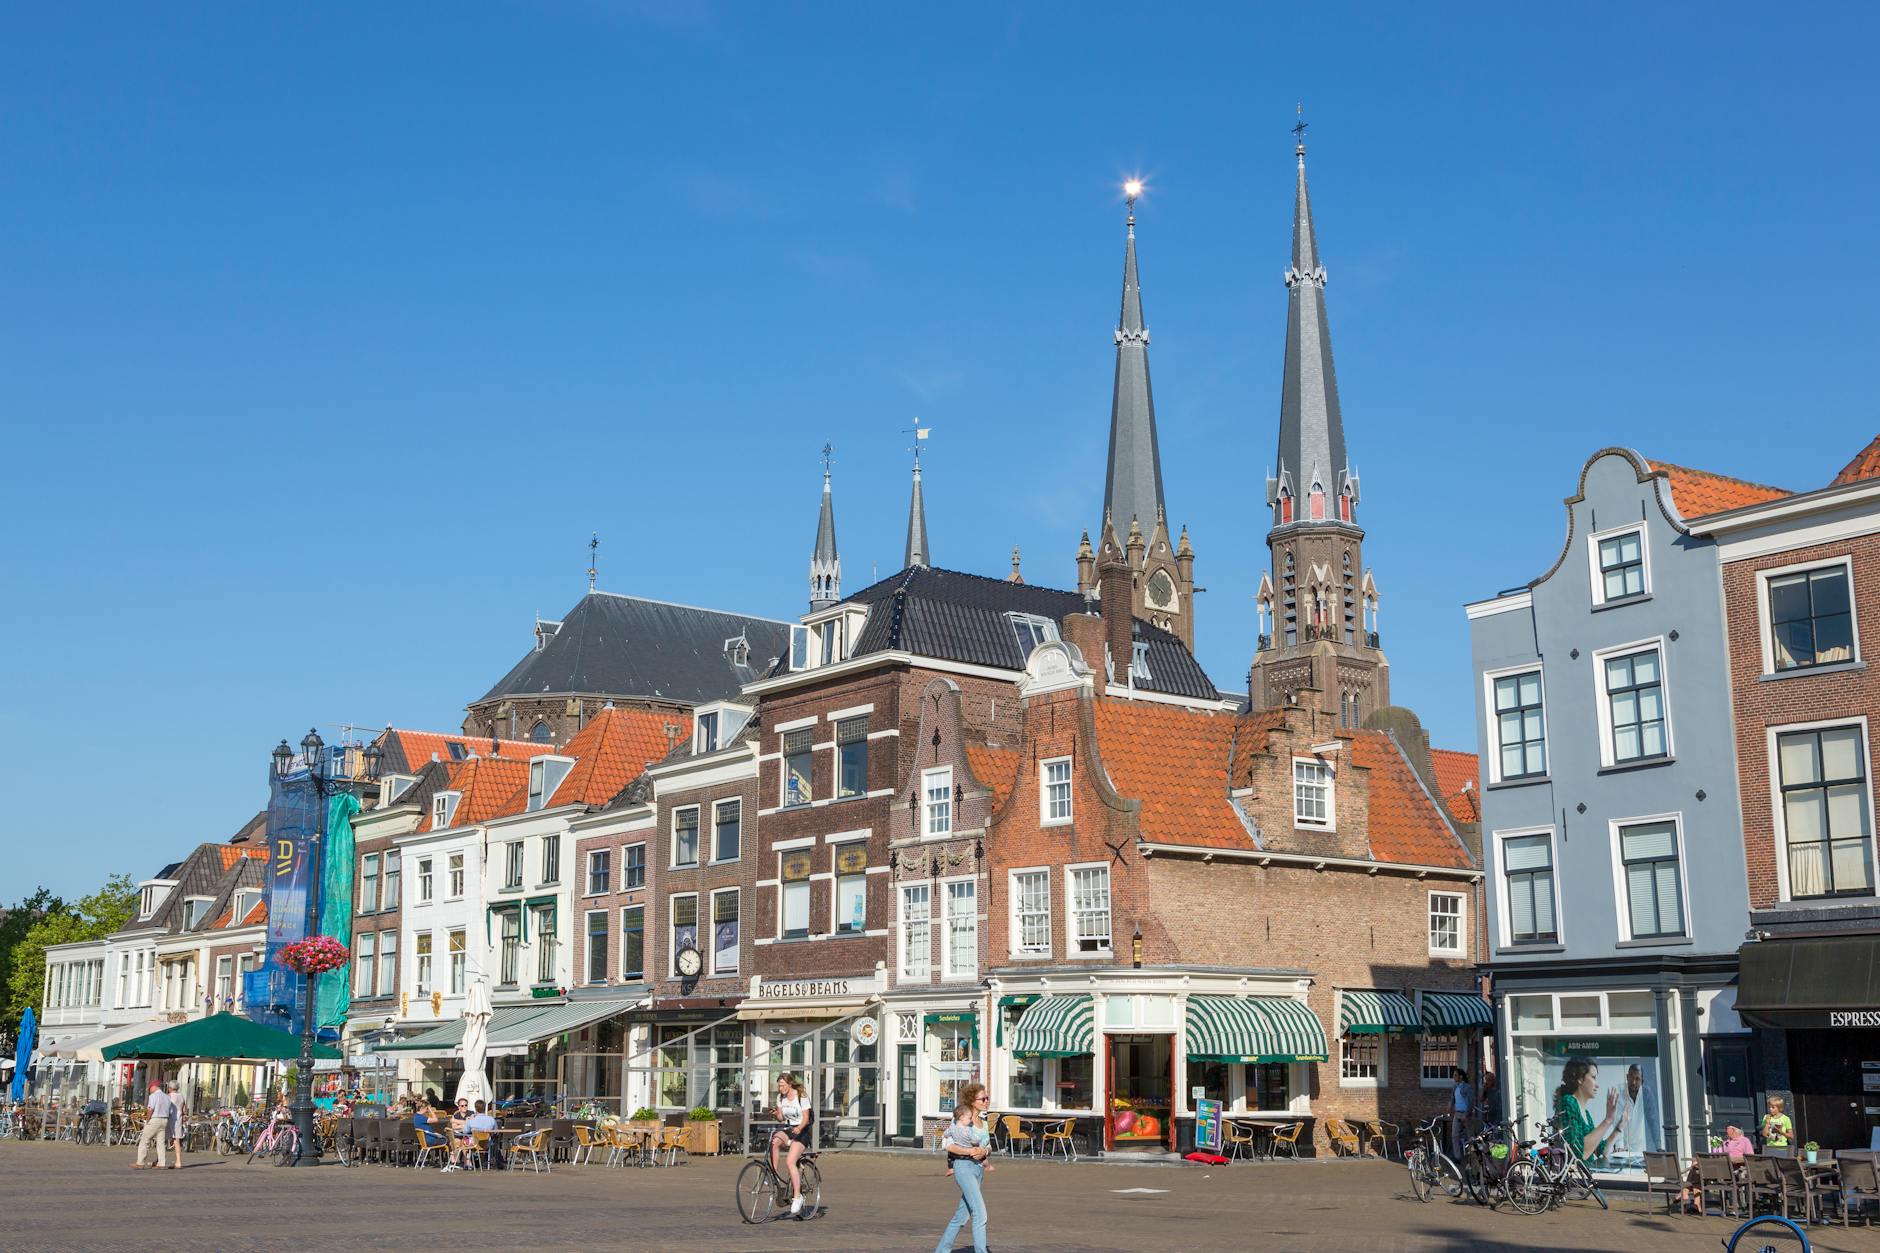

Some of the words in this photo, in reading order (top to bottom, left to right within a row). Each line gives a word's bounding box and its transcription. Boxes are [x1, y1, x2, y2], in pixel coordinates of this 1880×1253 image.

[277, 840, 294, 860] D
[759, 983, 800, 998] BAGELS
[810, 981, 848, 995] BEANS
